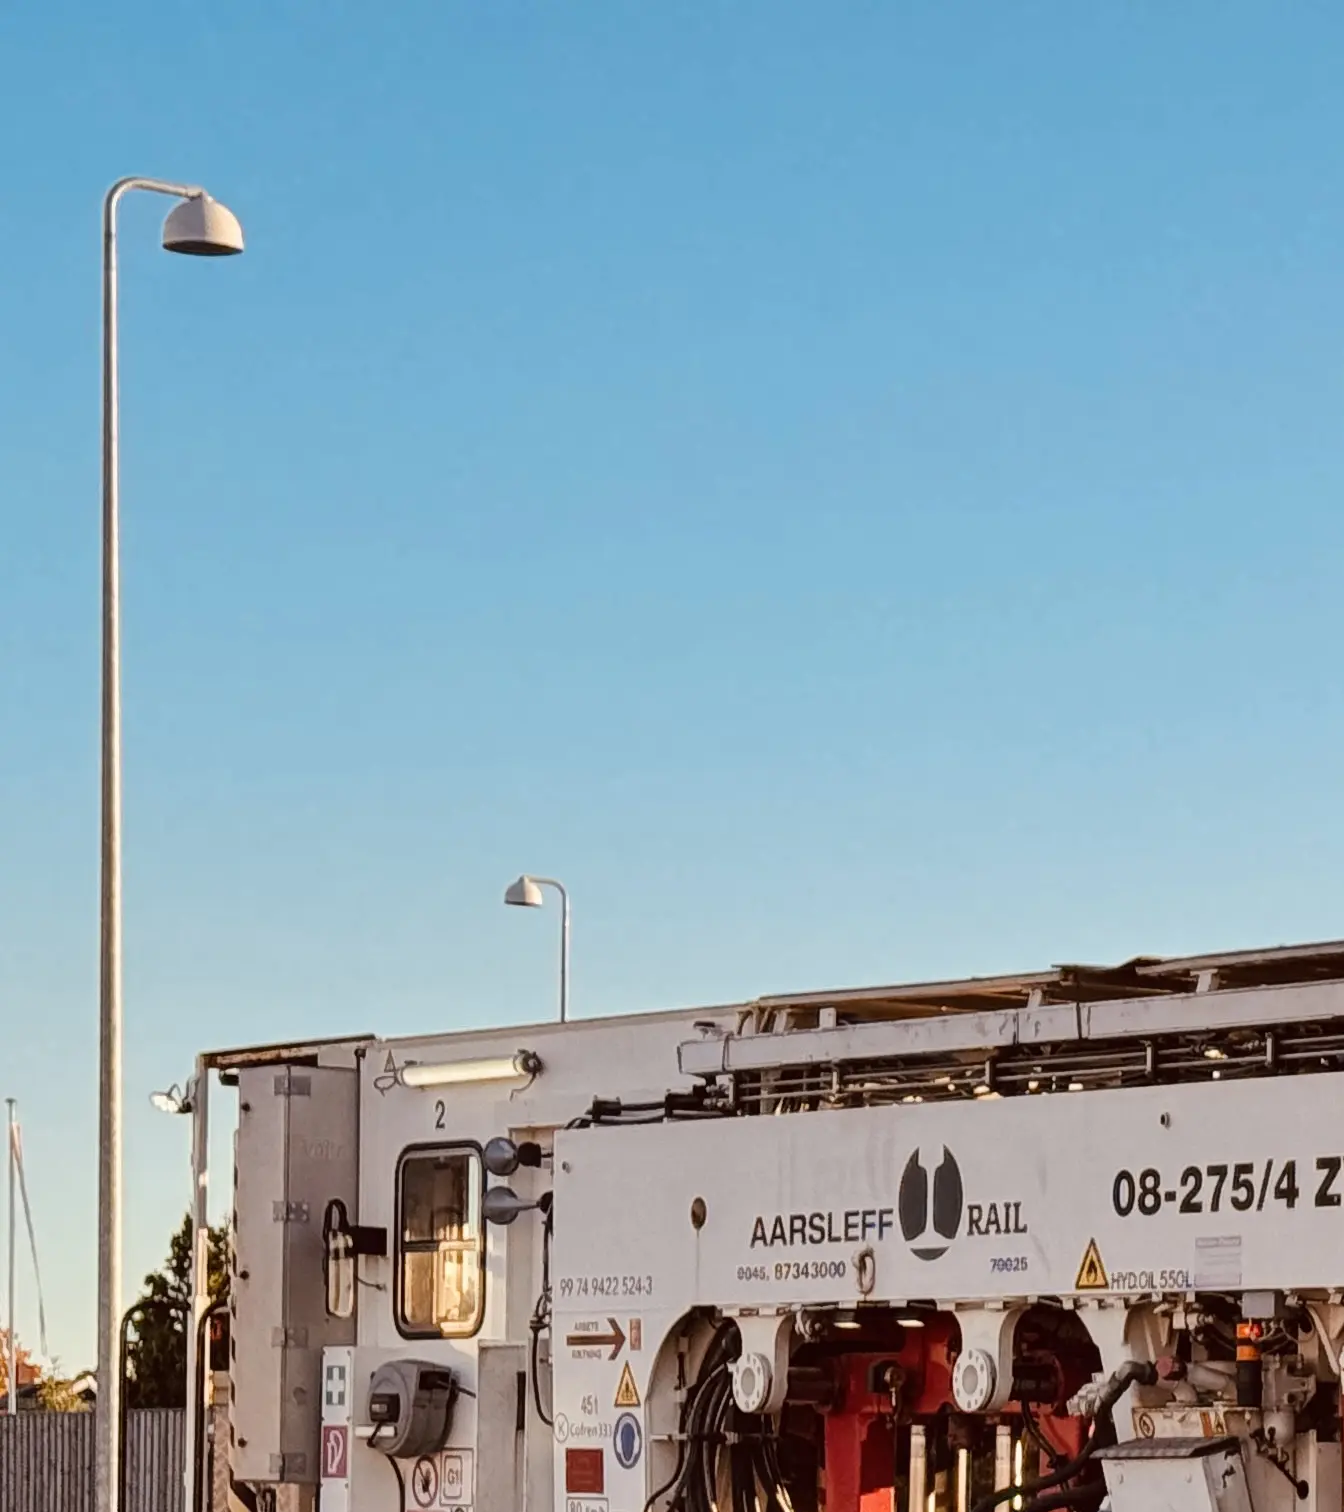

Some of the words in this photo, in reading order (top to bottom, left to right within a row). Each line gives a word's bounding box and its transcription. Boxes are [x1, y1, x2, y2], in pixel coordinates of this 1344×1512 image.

[435, 1099, 446, 1130] 2
[1112, 1158, 1300, 1217] 08-275/4
[750, 1207, 894, 1249] AARSLEFF
[966, 1201, 1028, 1236] RAIL
[560, 1278, 574, 1297] 99
[576, 1277, 589, 1296] 74
[591, 1276, 620, 1296] 9422
